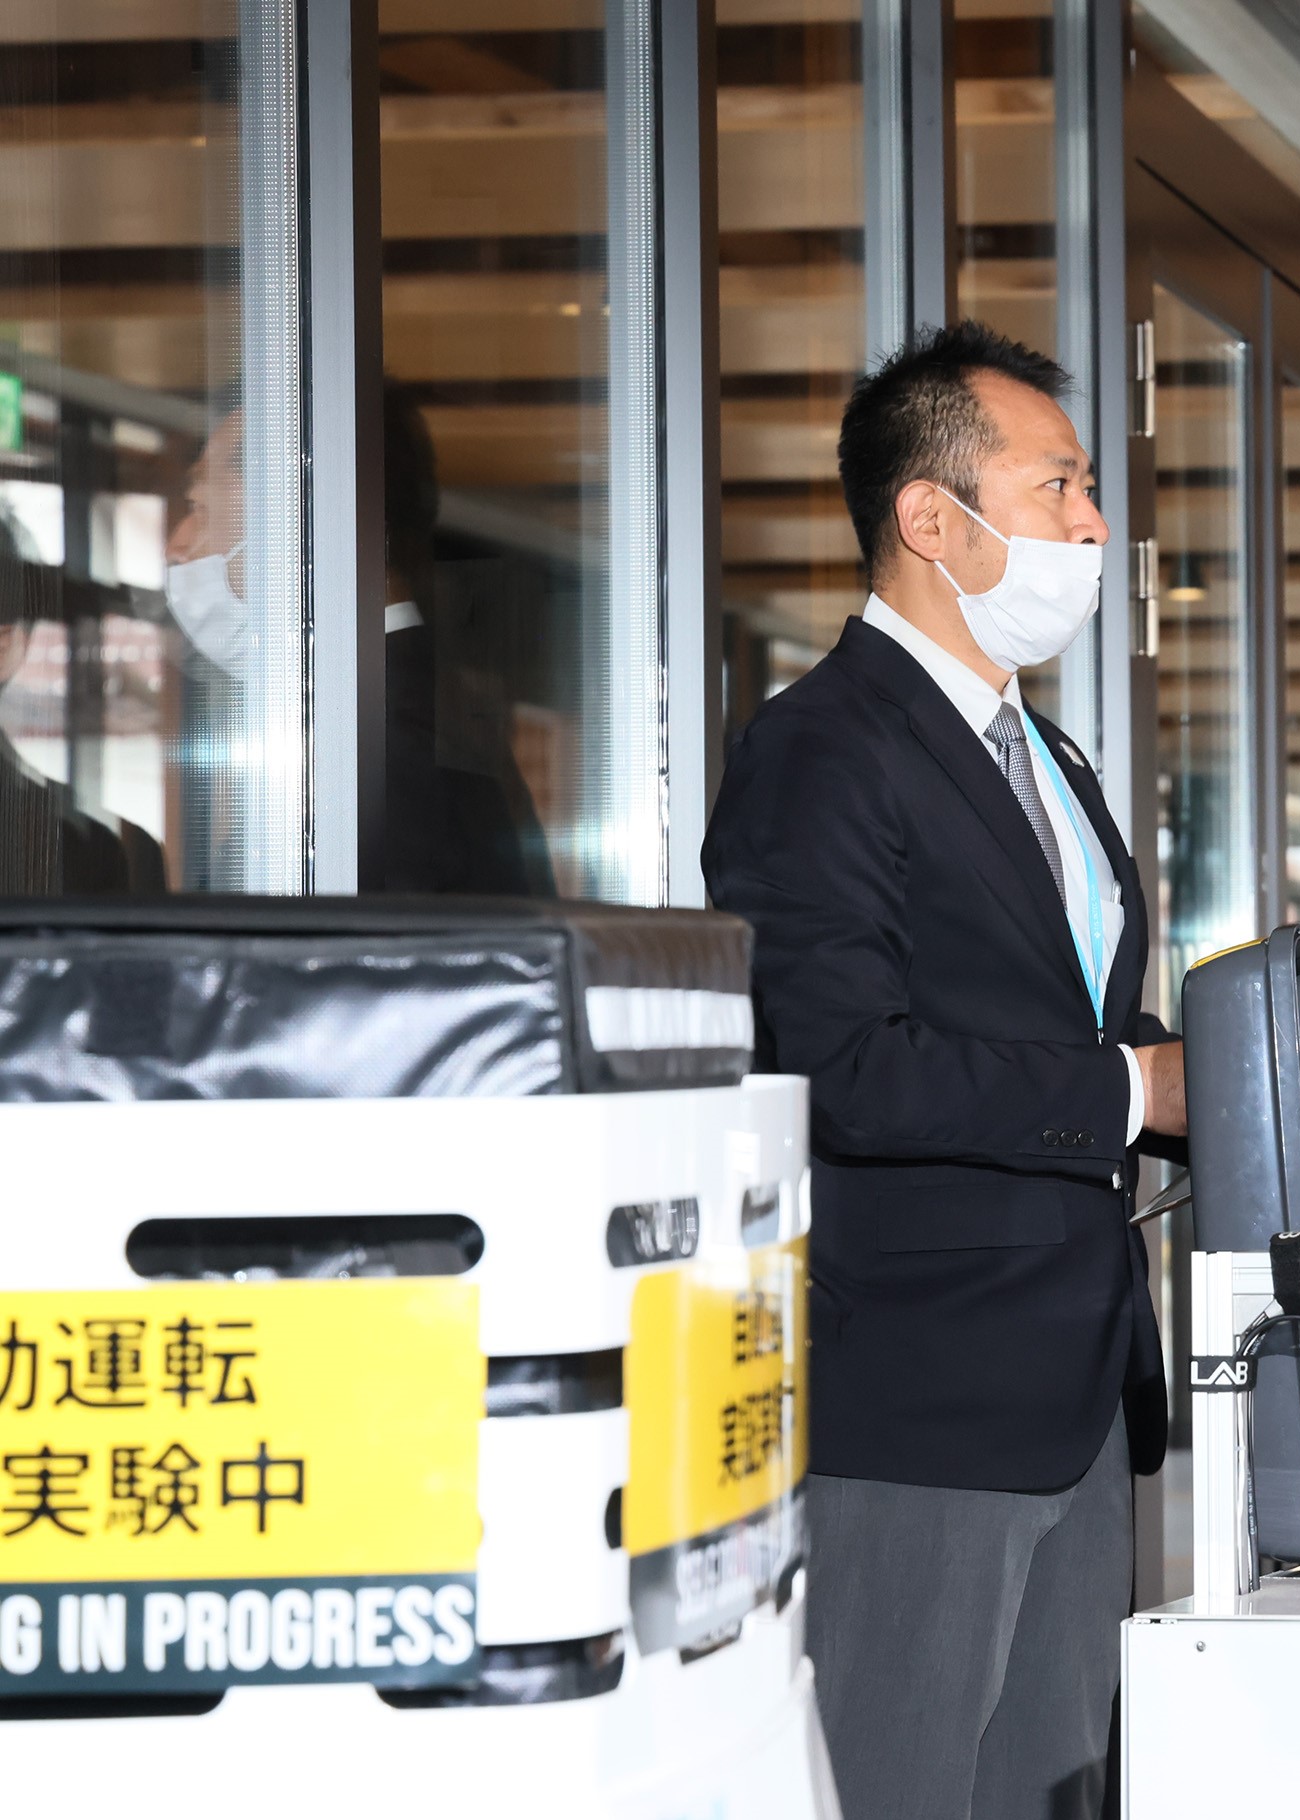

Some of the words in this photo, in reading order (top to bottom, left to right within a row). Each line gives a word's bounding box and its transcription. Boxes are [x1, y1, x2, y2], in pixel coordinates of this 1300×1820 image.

[1190, 1361, 1248, 1385] LAB
[2, 1441, 305, 1537] 実験中
[57, 1593, 127, 1674] IN
[142, 1584, 476, 1672] PROGRESS
